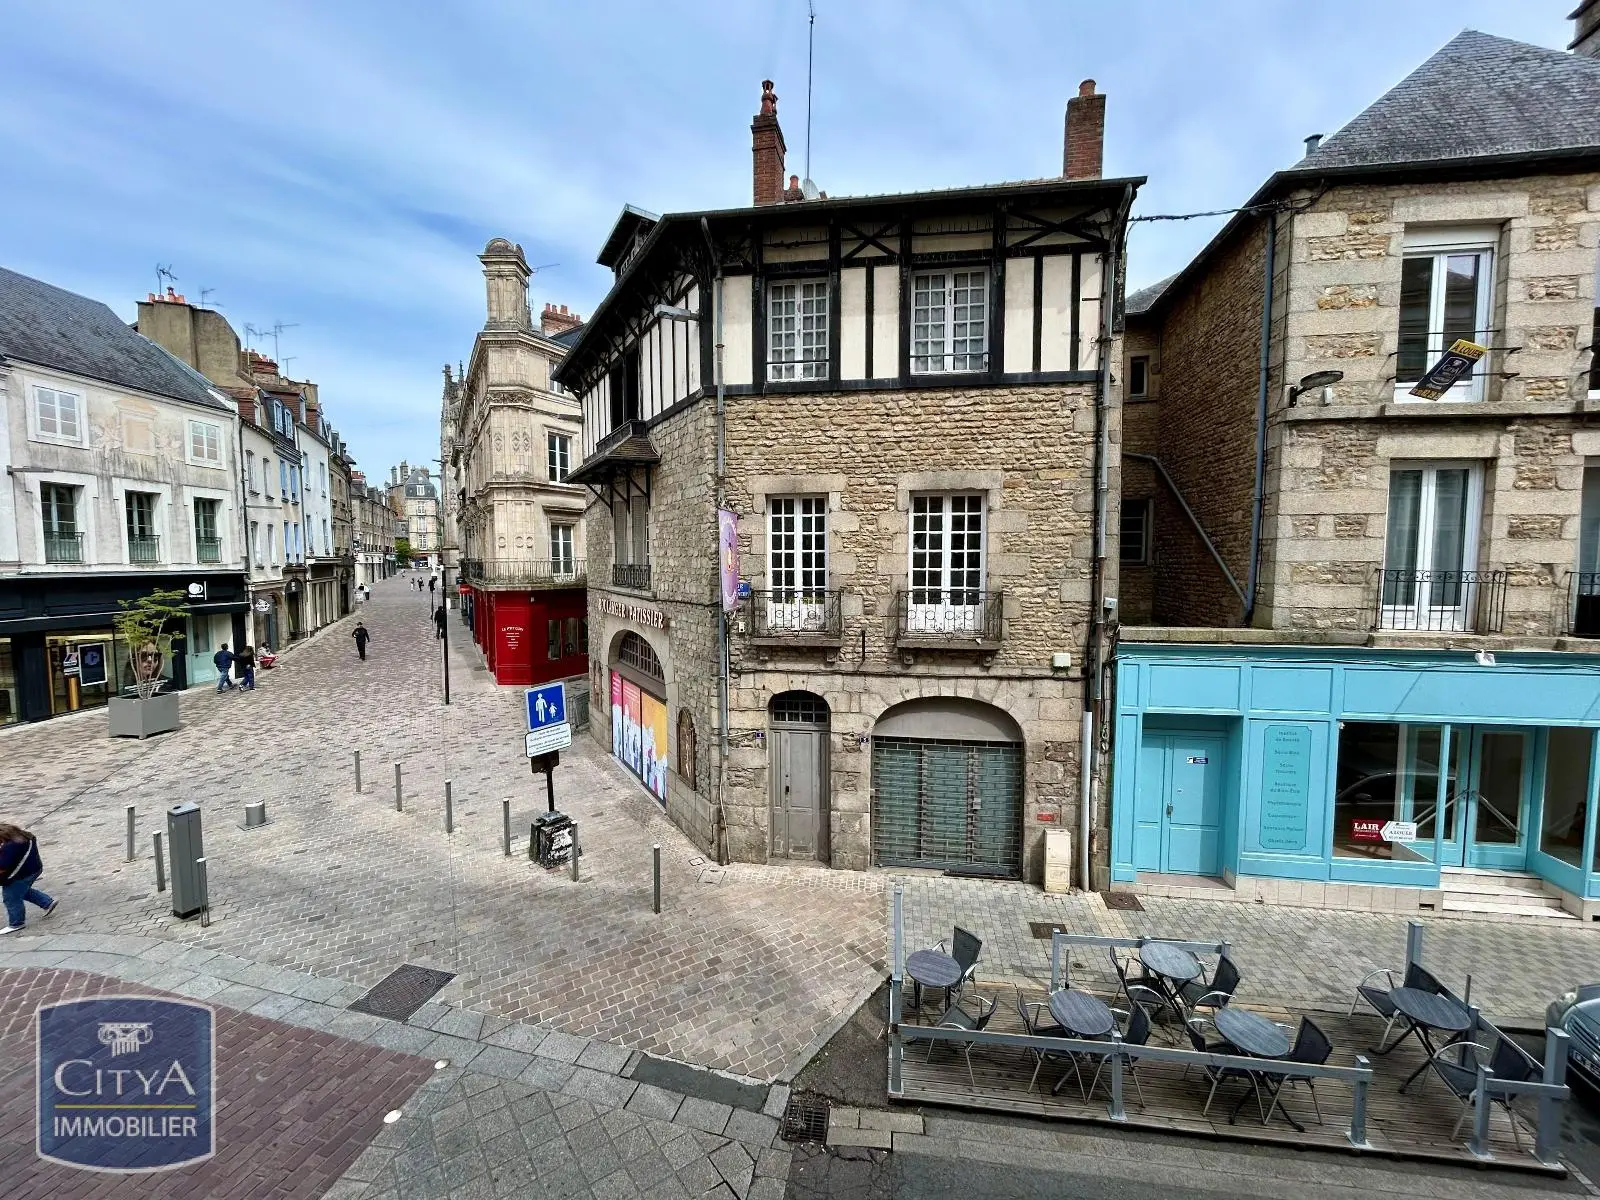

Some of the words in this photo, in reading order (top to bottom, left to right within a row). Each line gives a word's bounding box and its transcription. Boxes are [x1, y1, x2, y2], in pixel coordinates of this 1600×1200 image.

[1459, 345, 1484, 358] LOUER
[628, 605, 664, 629] PATISSIER
[1354, 822, 1380, 831] LAIR
